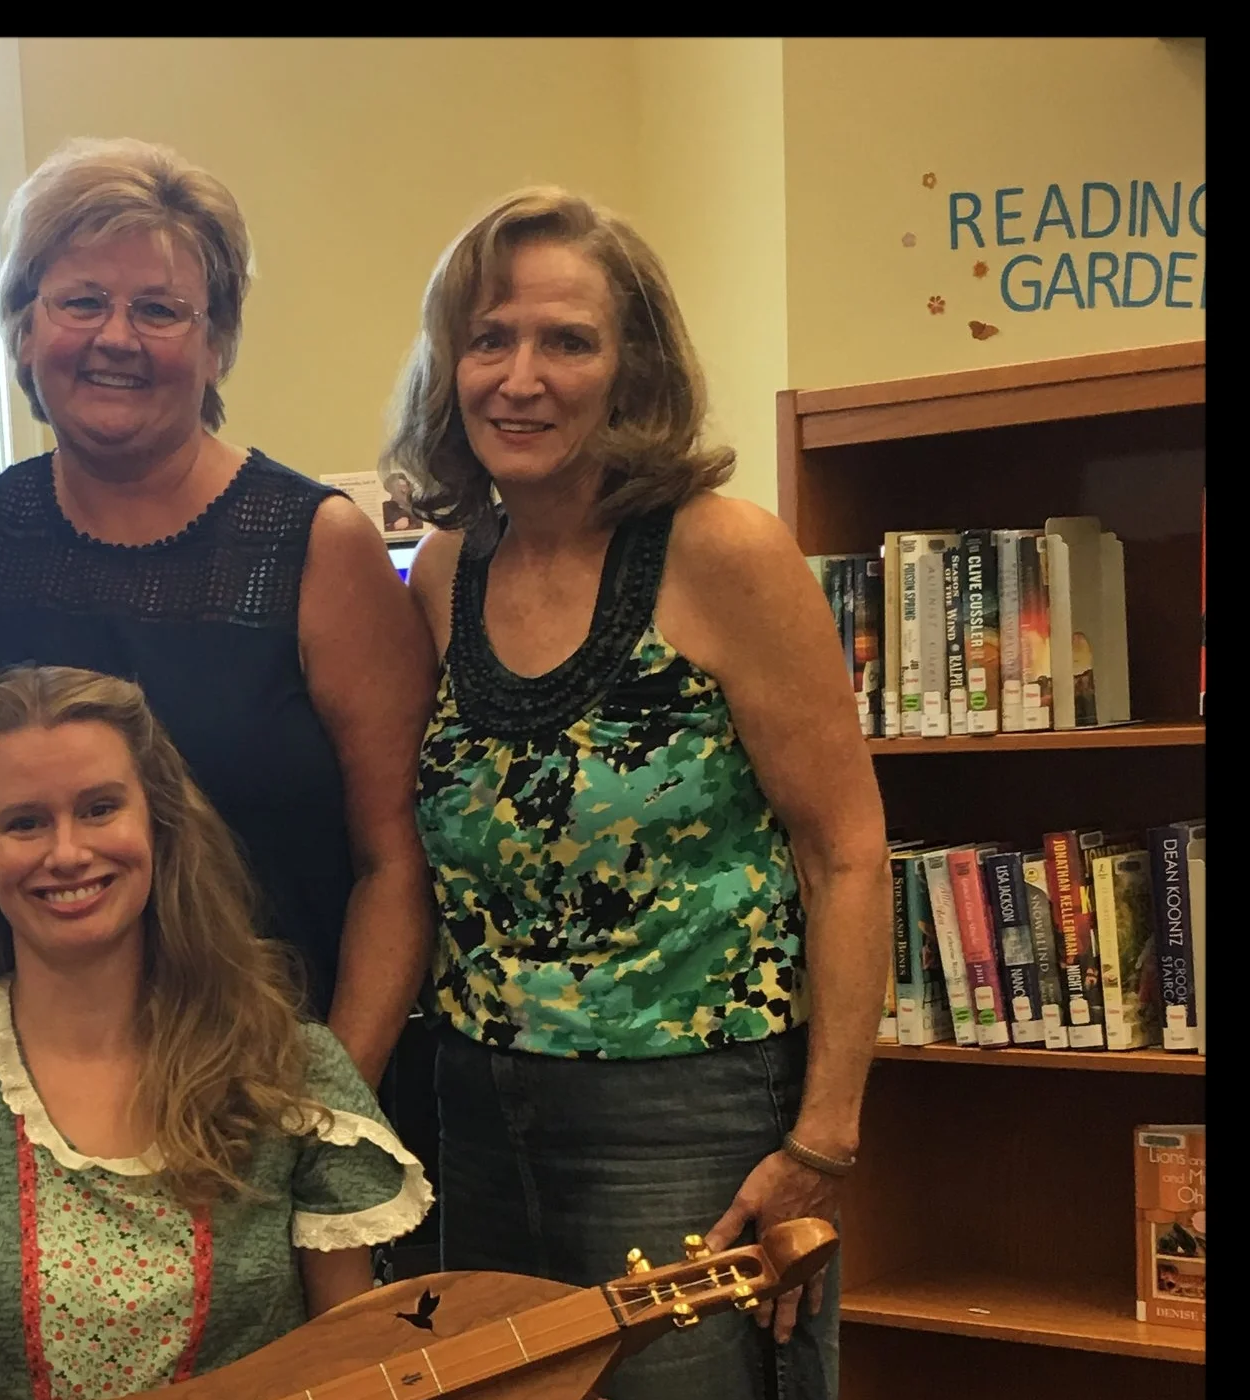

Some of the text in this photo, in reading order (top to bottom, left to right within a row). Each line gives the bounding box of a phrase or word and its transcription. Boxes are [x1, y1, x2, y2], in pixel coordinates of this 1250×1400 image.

[1000, 251, 1206, 313] GARDE
[904, 563, 916, 591] POISON
[967, 555, 982, 591] CLIVE
[904, 592, 916, 621] SPRING
[969, 592, 984, 648] CUSSLER
[946, 608, 958, 641] WIND
[949, 655, 963, 686] RALPH
[1052, 839, 1070, 891] JONATHAN
[1163, 838, 1183, 947] DEAN KOONTZ
[996, 864, 1026, 997] LISA JACKSON NANC
[1029, 894, 1050, 973] SNOWBLIND
[1059, 893, 1079, 957] KELLERMAN
[1066, 964, 1083, 991] NIGHT
[1174, 958, 1188, 1003] CROOK
[1149, 1147, 1186, 1165] Lions
[1162, 1173, 1185, 1184] and
[1177, 1186, 1205, 1204] Oh
[1156, 1306, 1199, 1321] DENISE
